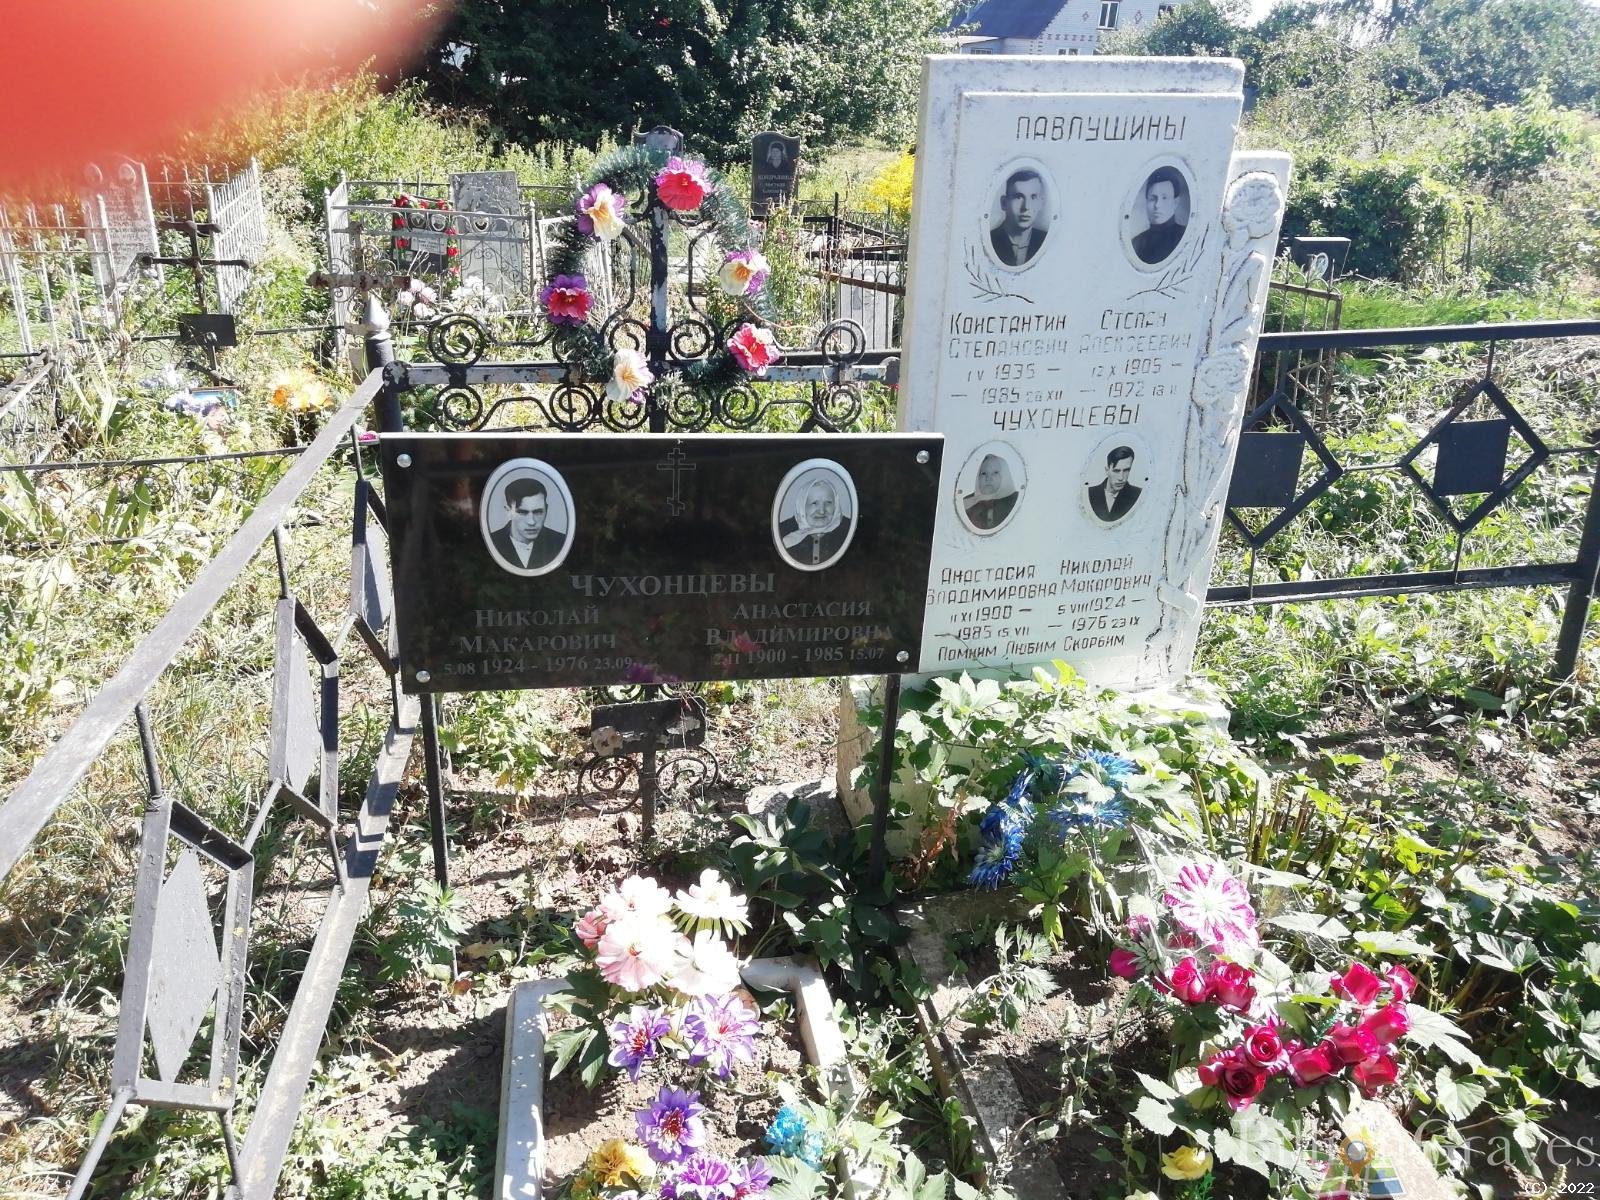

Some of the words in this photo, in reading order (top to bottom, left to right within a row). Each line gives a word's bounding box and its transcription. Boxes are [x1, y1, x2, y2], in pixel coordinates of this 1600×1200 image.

[1015, 115, 1187, 142] ПАВЛУШИНЫ
[994, 362, 1036, 381] 1935
[1125, 358, 1163, 375] 1905
[1108, 381, 1145, 398] 1972
[992, 404, 1140, 431] ЧУХОНЦЕВЫ
[1089, 595, 1126, 612] 1924
[976, 605, 1013, 622] 1900
[1072, 615, 1108, 632] 1976
[1111, 617, 1126, 629] 23
[958, 625, 992, 641] 1985
[748, 647, 787, 664] 1900
[804, 646, 844, 662] 1985
[481, 657, 526, 675] 1924
[547, 656, 588, 672] 1976
[593, 656, 633, 671] 23.09
